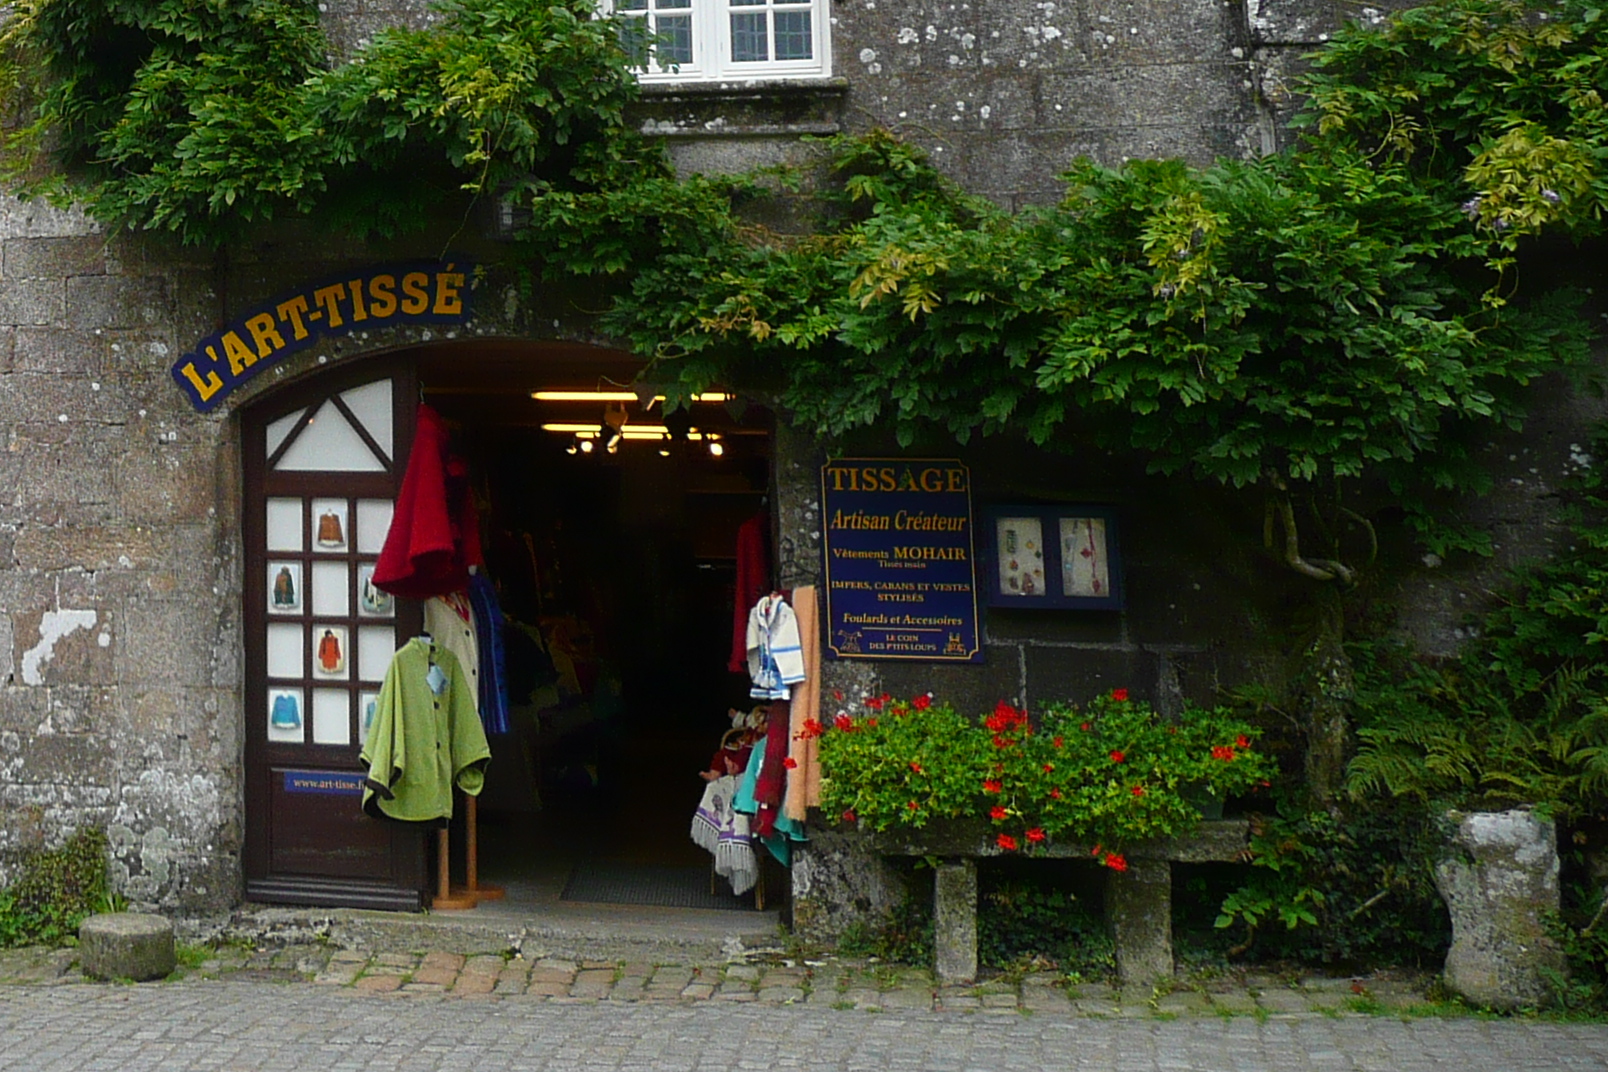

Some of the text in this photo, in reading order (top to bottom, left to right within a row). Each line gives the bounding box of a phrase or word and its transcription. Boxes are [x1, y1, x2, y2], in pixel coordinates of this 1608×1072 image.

[181, 262, 465, 403] L'ART-TISSÉ
[827, 467, 966, 492] TISSAGE
[831, 508, 967, 531] Artisan Créateur
[833, 546, 967, 561] Vêtements MOHAIR
[874, 581, 916, 591] CABANS
[917, 581, 931, 591] ET
[933, 583, 971, 592] VESTES
[843, 612, 963, 626] Foulards et Accessoires
